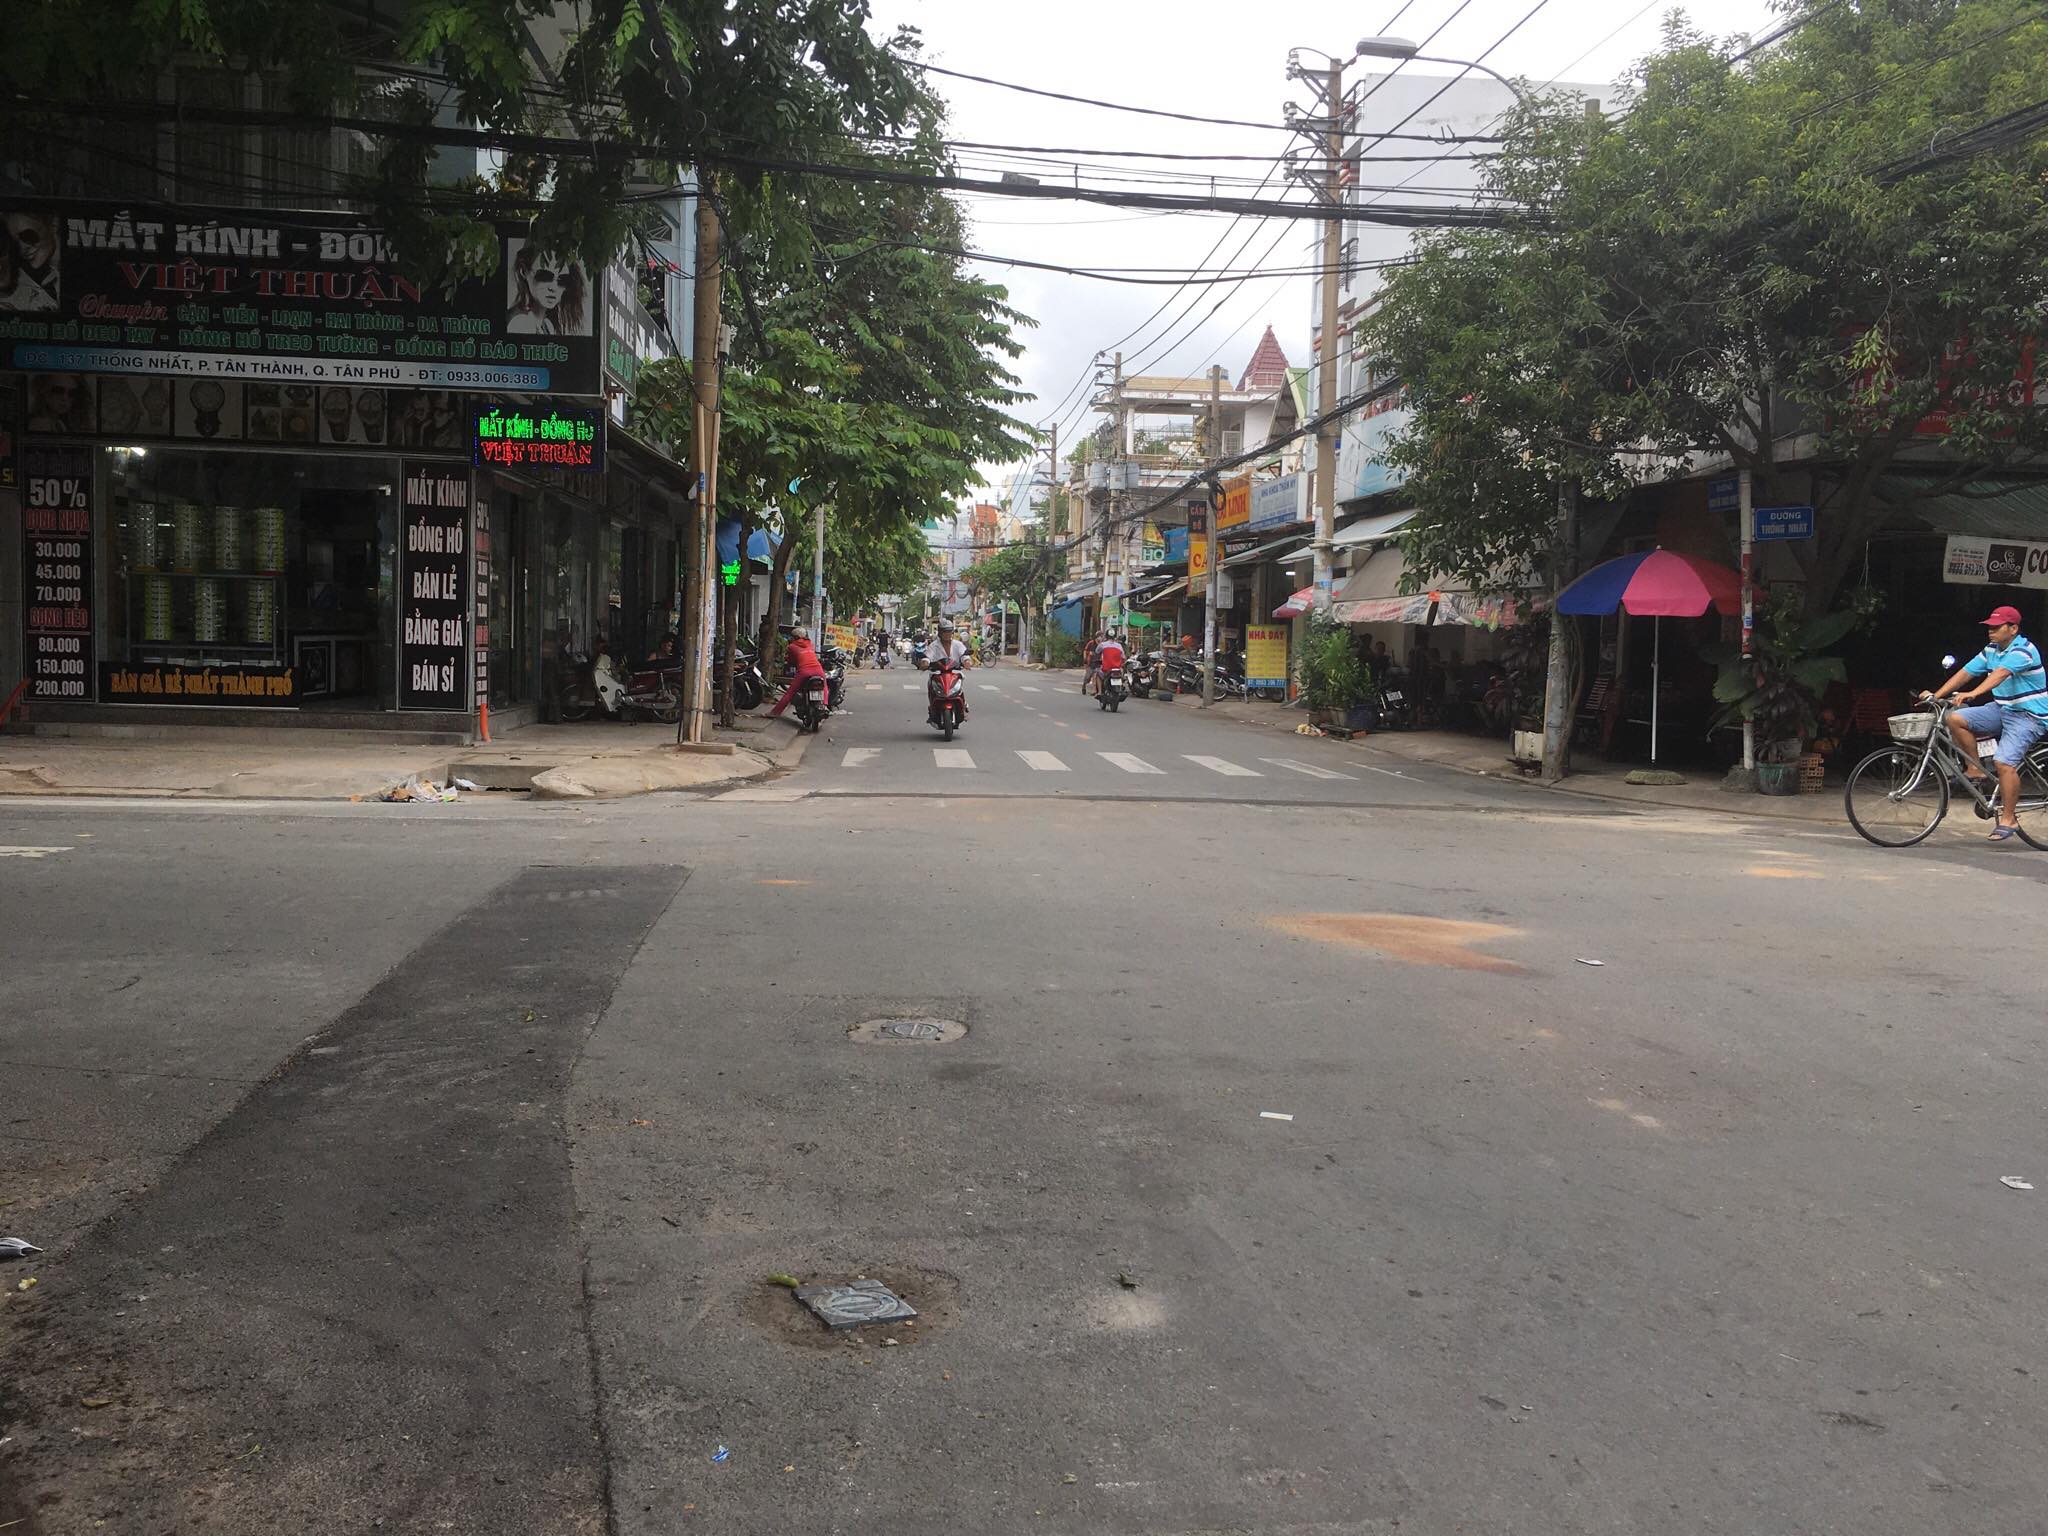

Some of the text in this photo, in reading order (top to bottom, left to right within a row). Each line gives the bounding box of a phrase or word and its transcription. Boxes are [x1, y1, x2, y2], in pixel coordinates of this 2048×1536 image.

[66, 210, 163, 251] MẮT
[175, 220, 281, 257] KÍNH
[117, 256, 421, 307] VIỆT THUẬN
[80, 294, 168, 324] Chuyên
[272, 309, 313, 331] LOẠN
[325, 312, 352, 330] HAI
[356, 311, 405, 332] TRÒNG
[443, 314, 491, 335] TRÒNG
[53, 317, 78, 341] HỒ
[82, 323, 121, 342] ĐEO
[127, 326, 156, 343] TAY
[179, 324, 231, 348] ĐỒNG
[235, 326, 261, 349] HỒ
[266, 333, 313, 352] TREO
[317, 334, 378, 354] TƯỜNG
[395, 335, 446, 357] ĐỒNG
[451, 336, 477, 358] HỒ
[480, 340, 517, 360] BÁO
[522, 340, 570, 362] THỨC
[90, 351, 143, 369] THỐNG
[148, 354, 193, 372] NHẤT,
[199, 359, 210, 371] P.
[216, 356, 246, 373] TÂN
[251, 358, 309, 376] THÀNH,
[313, 364, 329, 377] Q.
[334, 363, 364, 378] TÂN
[369, 363, 401, 379] PHÚ
[418, 369, 441, 380] ĐT:
[447, 371, 538, 385] 0933.006.388
[480, 409, 504, 438] MẮT
[505, 412, 534, 438] KÍNH
[541, 411, 574, 440] ĐỒNG
[481, 439, 593, 466] VIỆT THUẬN
[30, 477, 86, 507] 50%
[407, 468, 467, 508] MẮT KÍNH
[35, 542, 81, 558] 30.000
[409, 515, 443, 553] ĐỒNG
[446, 517, 463, 554] HỒ
[35, 564, 81, 580] 45.000
[413, 566, 440, 600] BÁN
[442, 564, 457, 600] LẺ
[36, 586, 81, 602] 70.000
[405, 607, 440, 645] BẢNG
[442, 614, 463, 647] GIÁ
[38, 636, 80, 653] 80.000
[35, 659, 84, 674] 150.000
[412, 656, 455, 693] BÁN SỈ
[35, 680, 84, 696] 200.000
